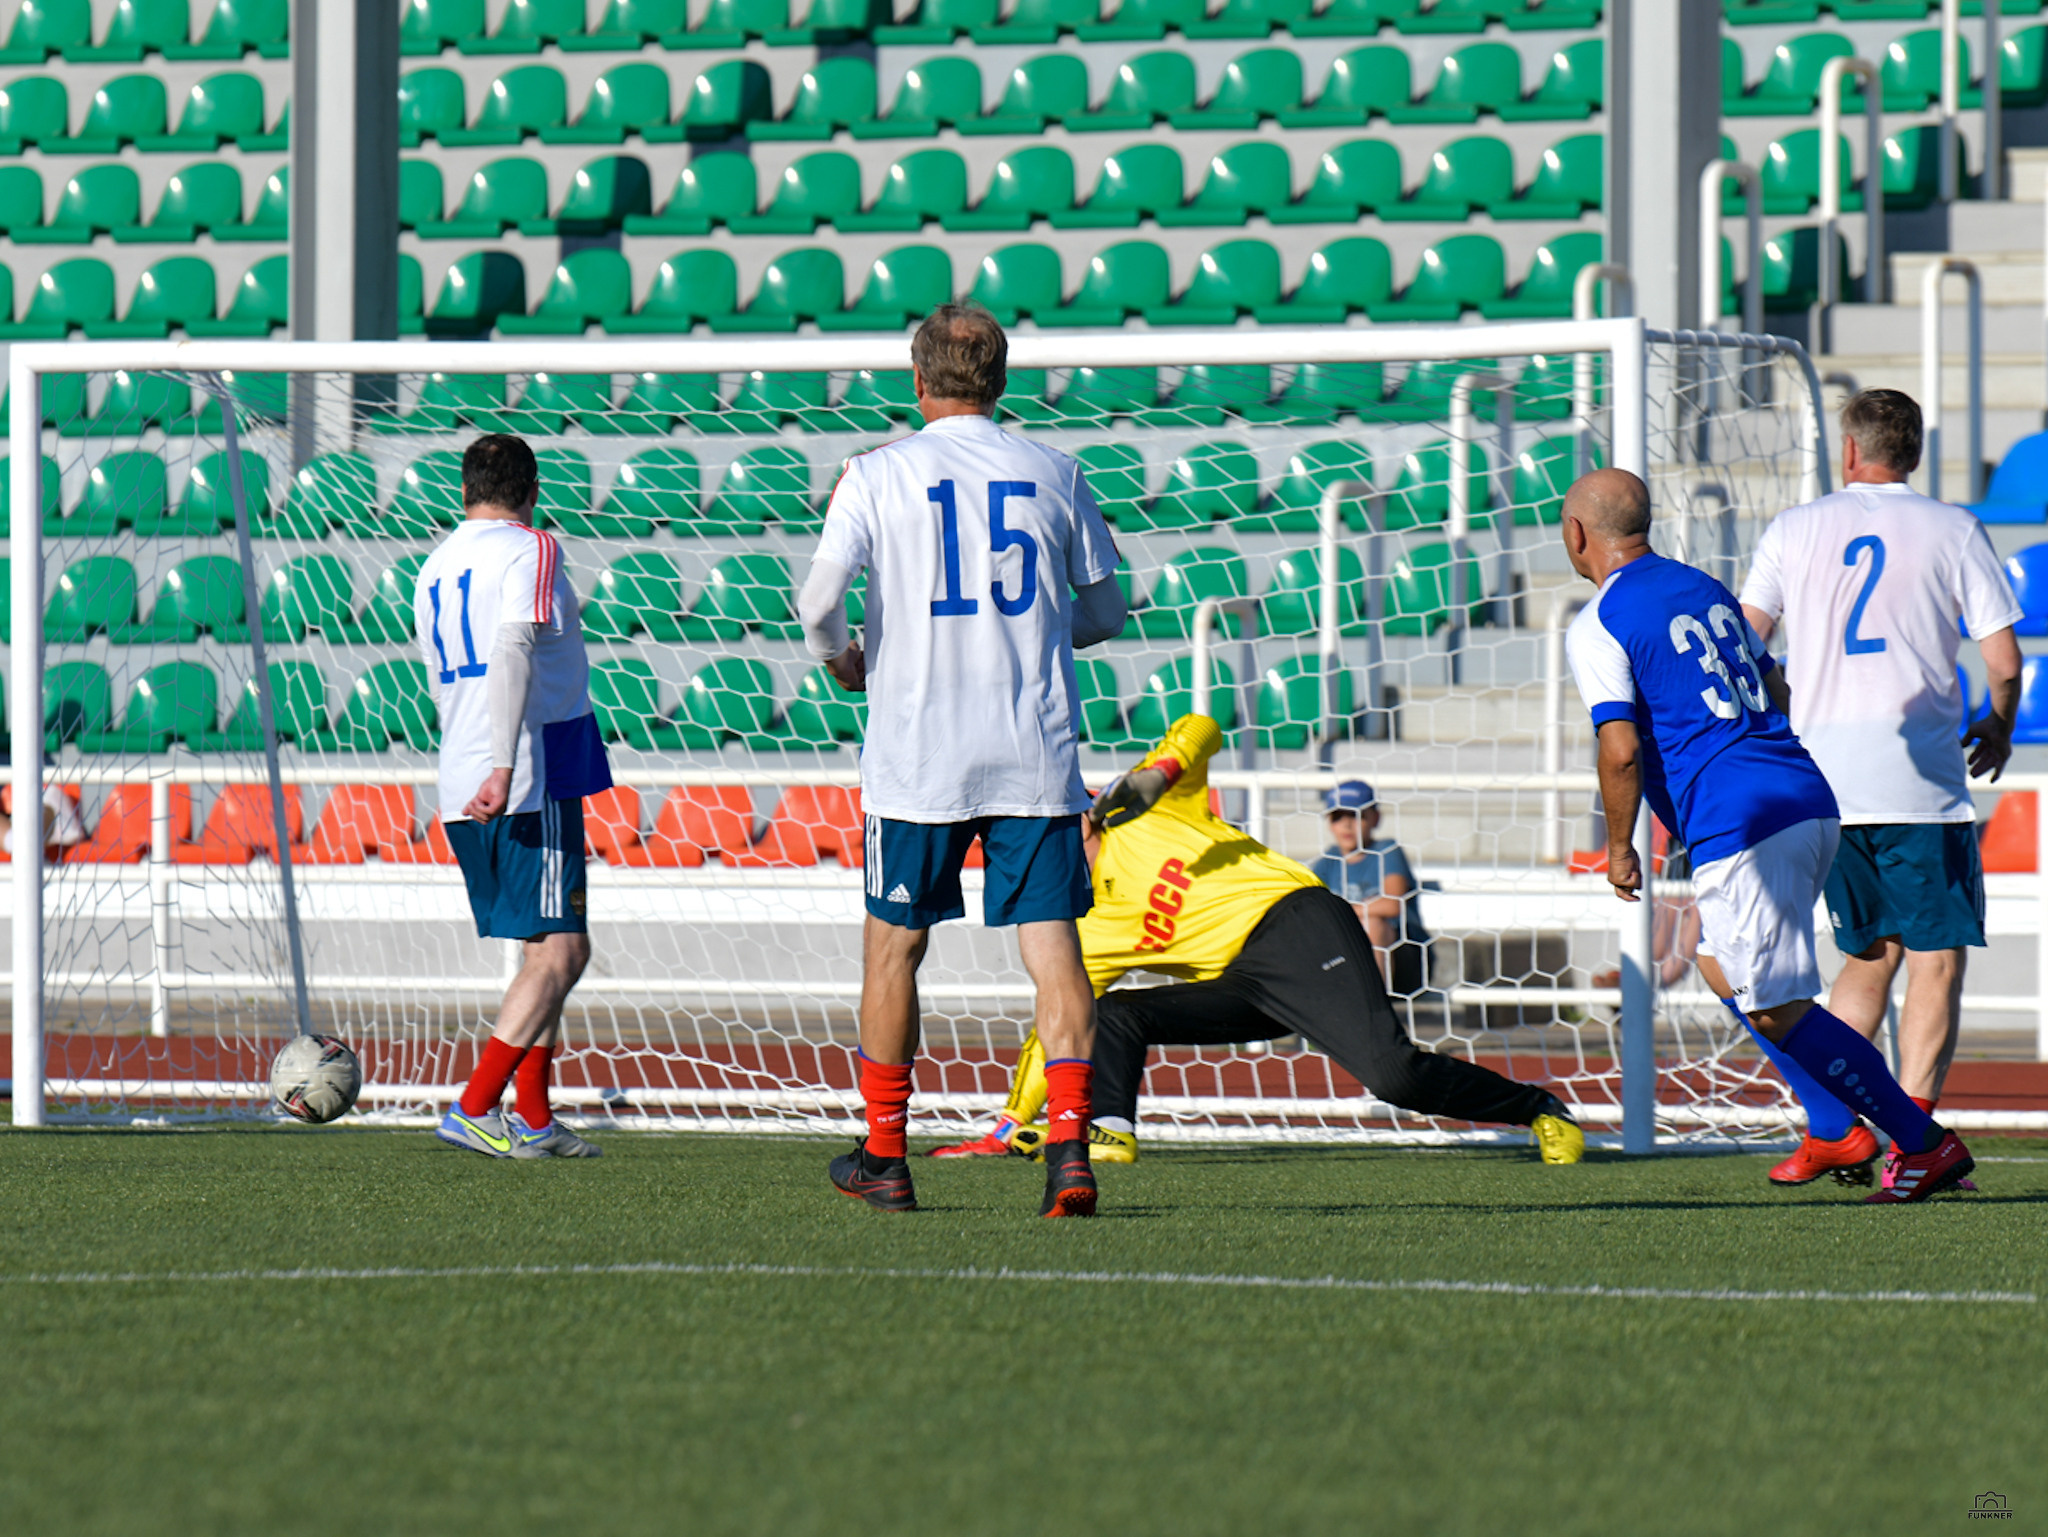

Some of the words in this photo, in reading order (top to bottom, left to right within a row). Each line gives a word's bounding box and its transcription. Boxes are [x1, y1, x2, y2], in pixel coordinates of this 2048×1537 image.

[926, 478, 1039, 618] 15
[1842, 534, 1887, 656] 2
[428, 567, 488, 685] 11
[1669, 603, 1769, 720] 33
